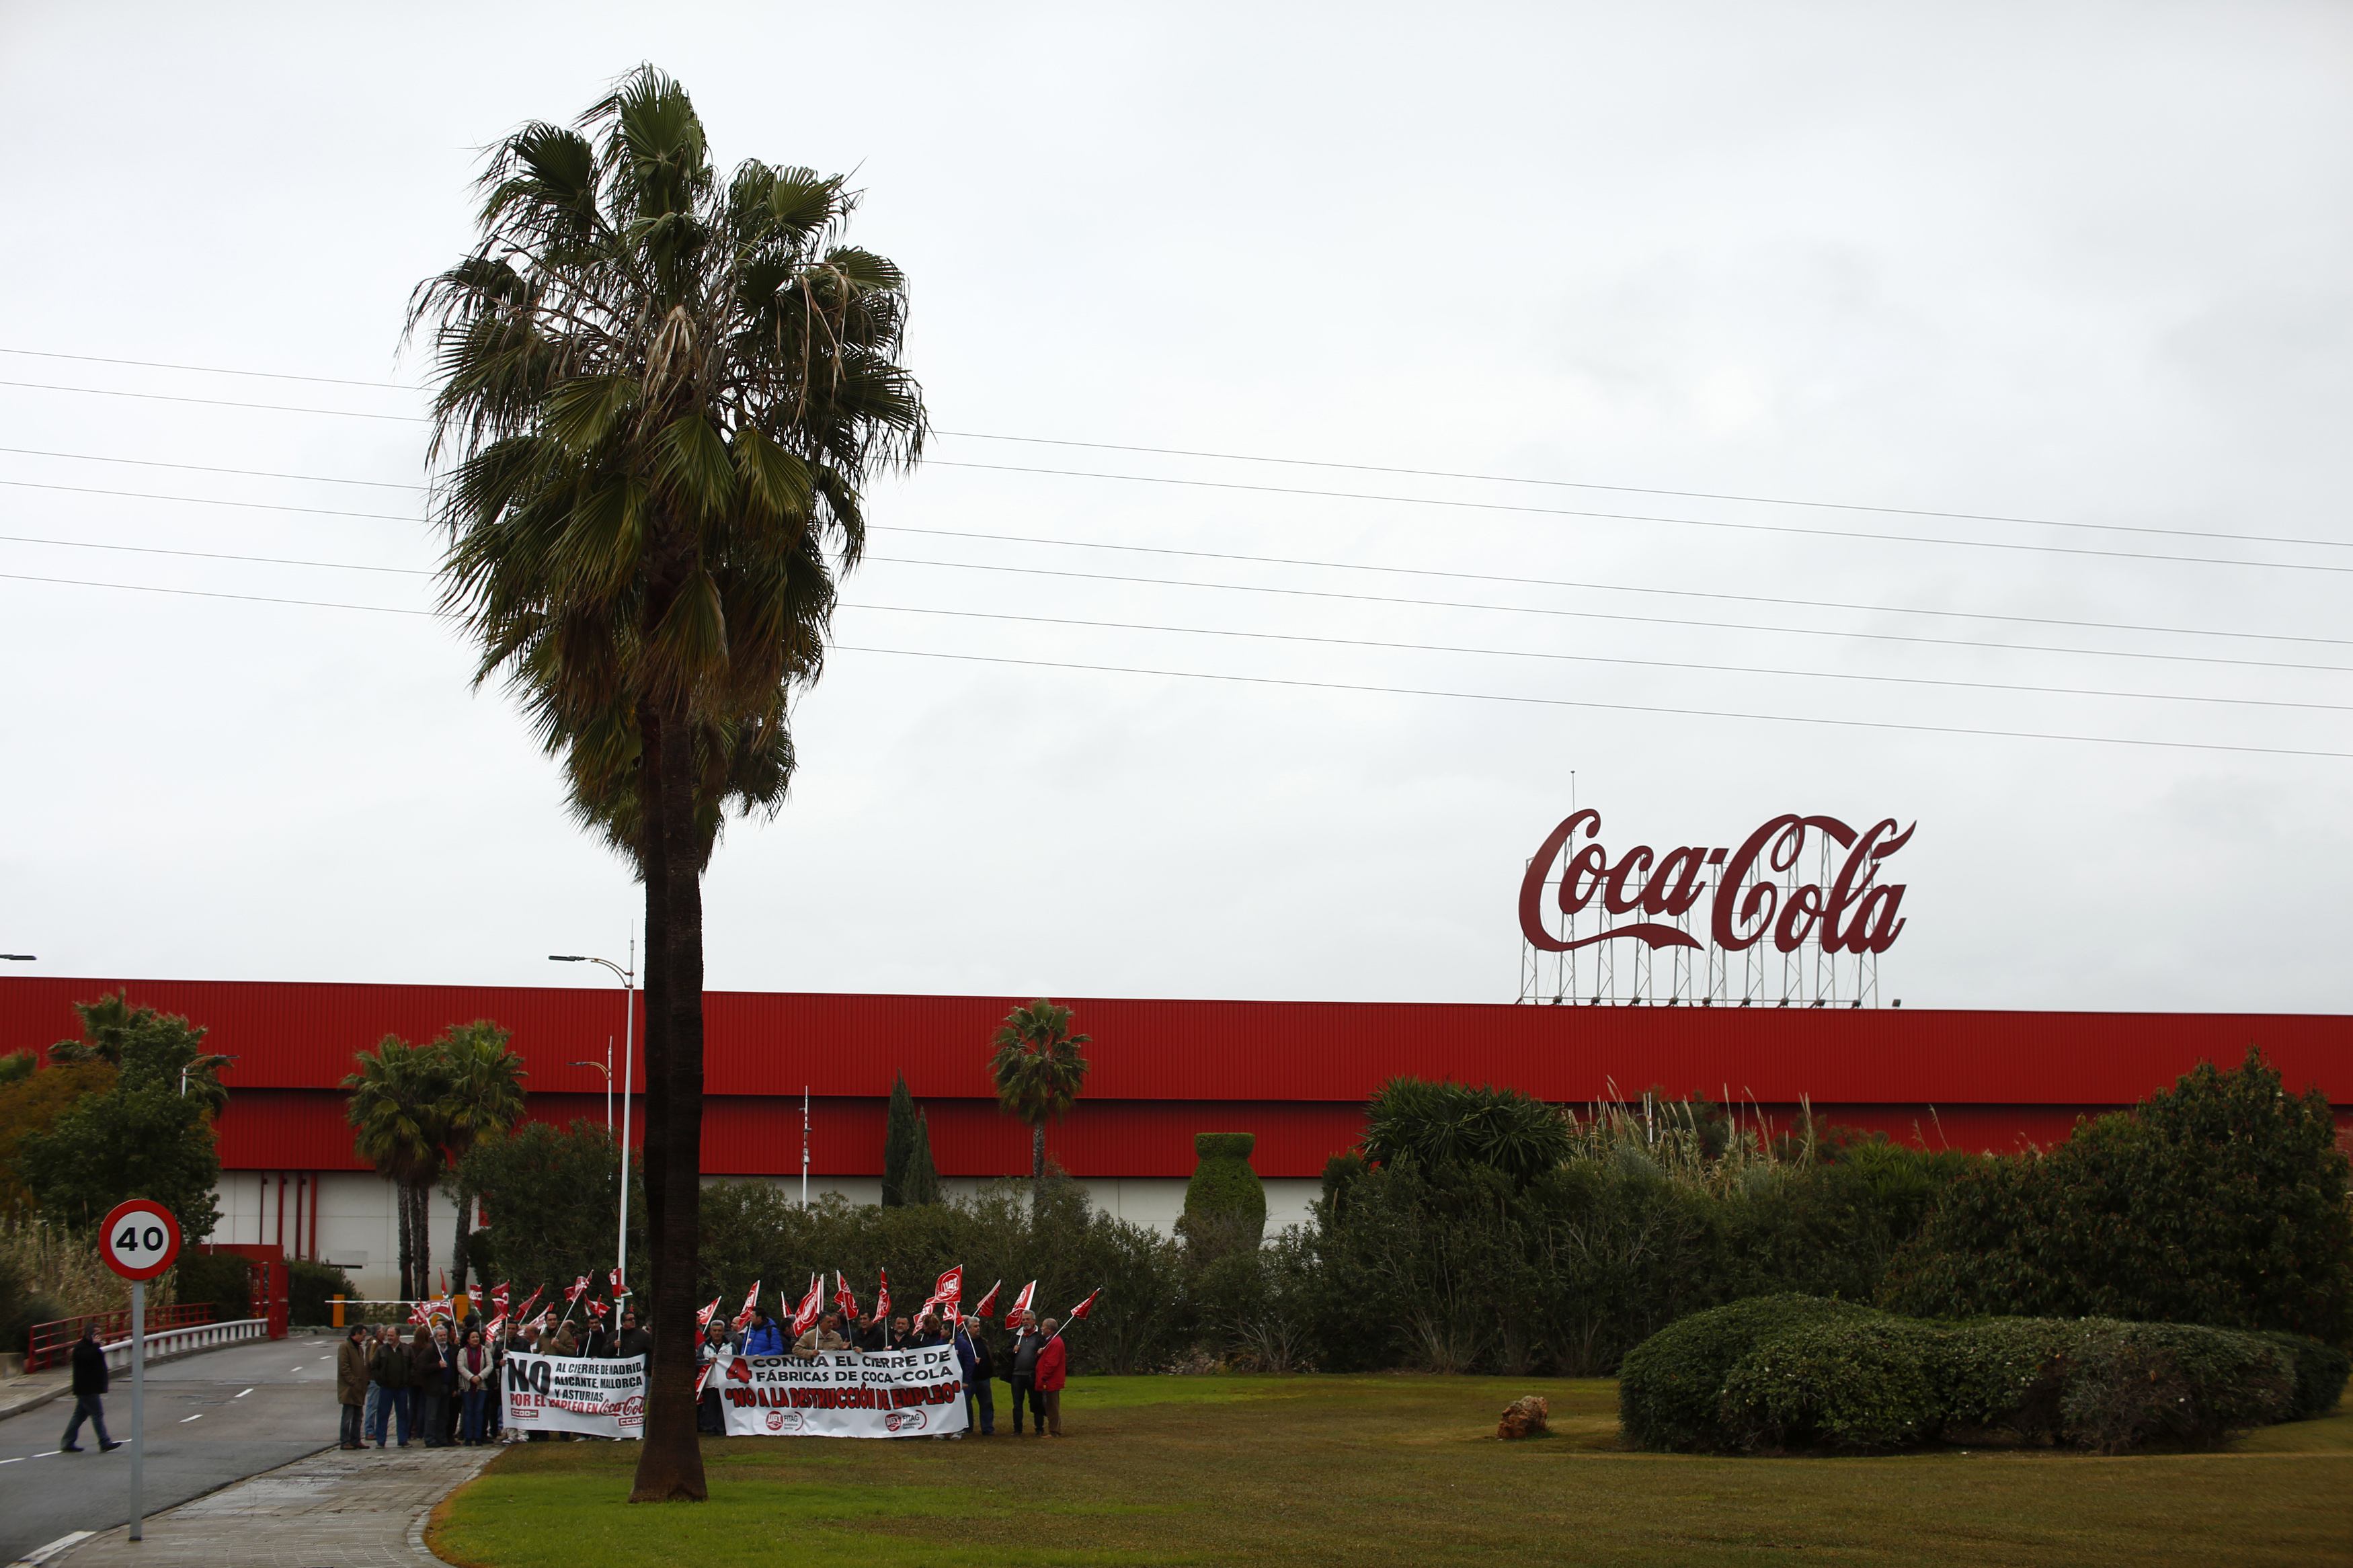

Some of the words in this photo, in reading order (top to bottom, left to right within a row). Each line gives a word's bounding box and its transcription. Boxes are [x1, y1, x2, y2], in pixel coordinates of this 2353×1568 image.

[1519, 809, 1917, 954] Coca-Cola
[116, 1227, 163, 1251] 40
[555, 1362, 566, 1372] AL
[568, 1364, 599, 1374] CIERRE
[600, 1364, 608, 1374] DE
[835, 1356, 858, 1367] EL
[862, 1355, 918, 1368] CIERRE
[923, 1350, 951, 1365] DE
[507, 1358, 551, 1396] NO
[726, 1357, 752, 1385] 4
[756, 1369, 830, 1382] FÁBRICAS
[835, 1371, 858, 1382] DE
[861, 1366, 953, 1383] COCA-COLA
[555, 1376, 598, 1389] ALICANTE,
[600, 1376, 643, 1389] MALLORCA
[510, 1393, 531, 1407] POR
[534, 1394, 546, 1407] EL
[586, 1402, 598, 1415] EN
[600, 1395, 645, 1417] Coca-Col
[555, 1389, 560, 1398] Y
[562, 1389, 604, 1403] ASTURIAS
[757, 1387, 770, 1408] A
[770, 1387, 790, 1408] LA
[876, 1388, 891, 1411] DE
[902, 1413, 920, 1422] FITAG
